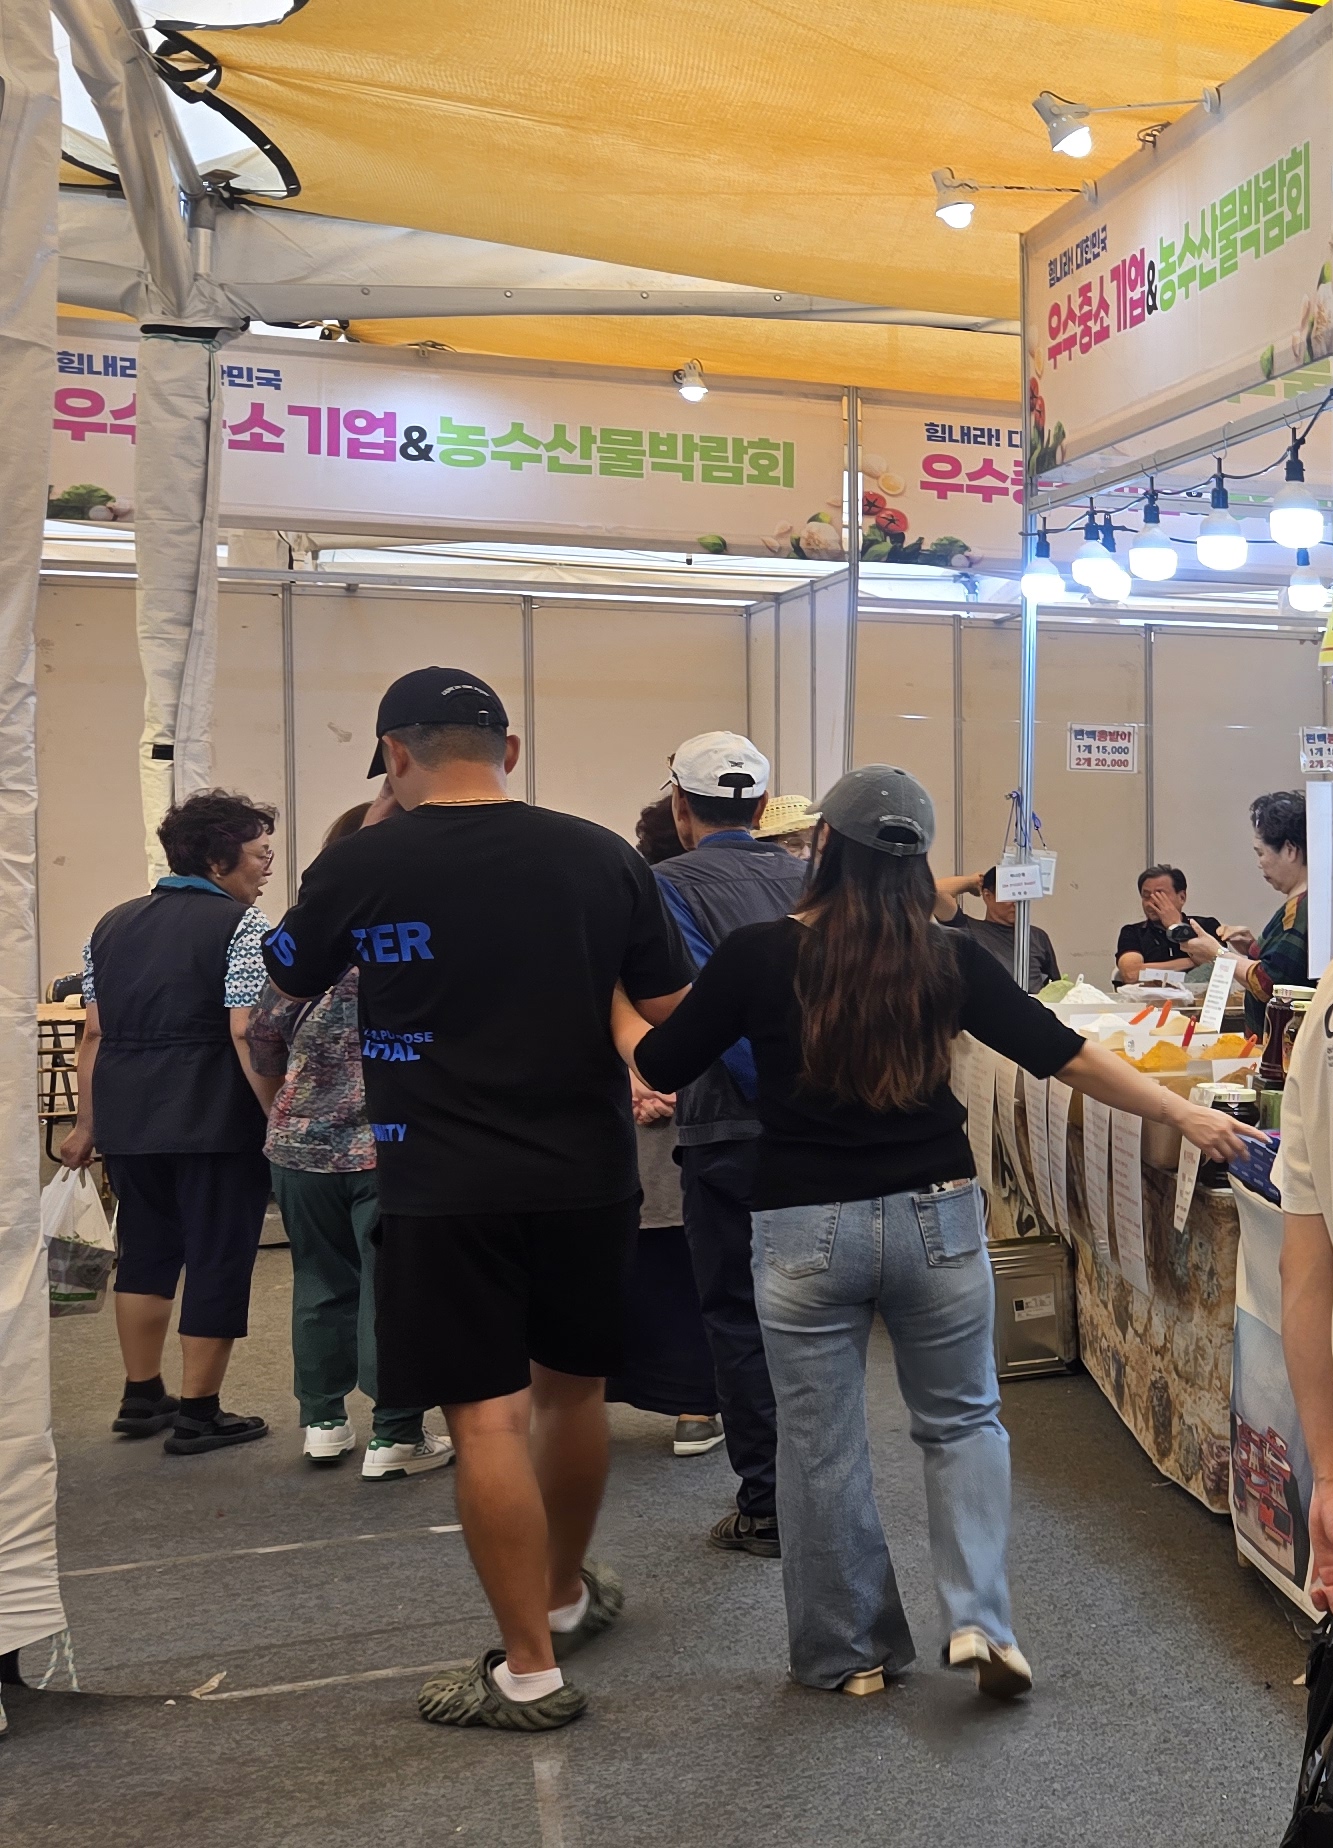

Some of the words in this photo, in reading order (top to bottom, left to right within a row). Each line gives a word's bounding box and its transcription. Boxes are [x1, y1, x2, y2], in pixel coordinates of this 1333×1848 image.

[1048, 239, 1074, 289] 힘내라!
[1075, 224, 1108, 271] 대한민국
[221, 364, 283, 391] 민국
[53, 386, 795, 488] 우수소기업&농수산물박람회
[924, 421, 1000, 448] 힘내라!
